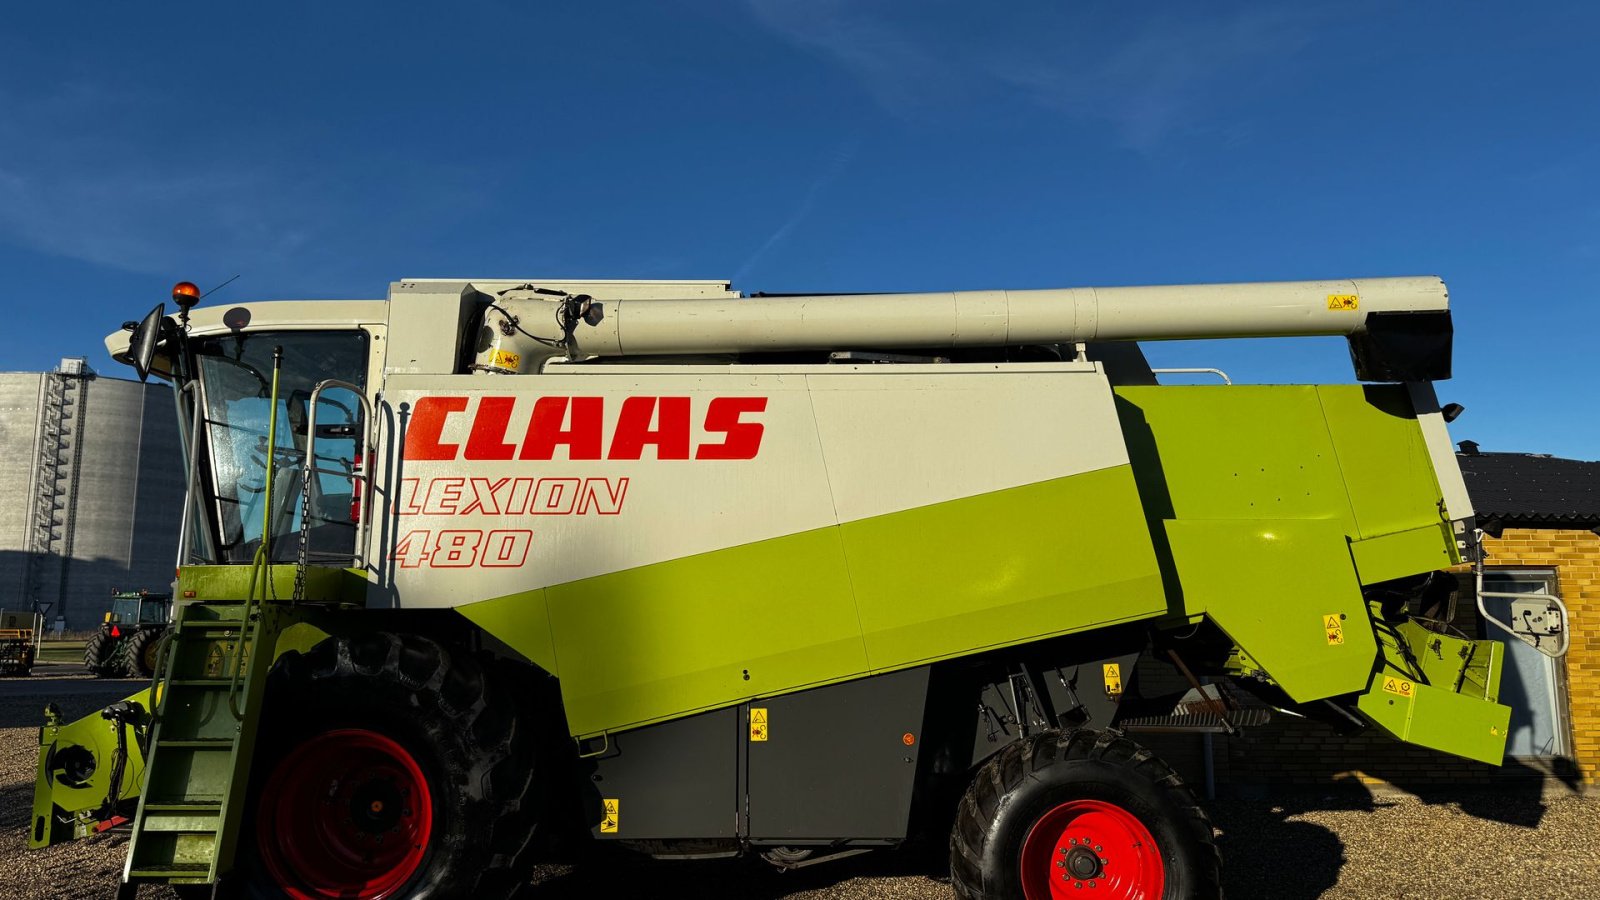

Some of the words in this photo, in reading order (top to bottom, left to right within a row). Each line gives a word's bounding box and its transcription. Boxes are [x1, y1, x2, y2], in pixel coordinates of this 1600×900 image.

[401, 395, 769, 461] CLAAS
[391, 477, 630, 516] LEXION
[387, 529, 534, 569] 480
